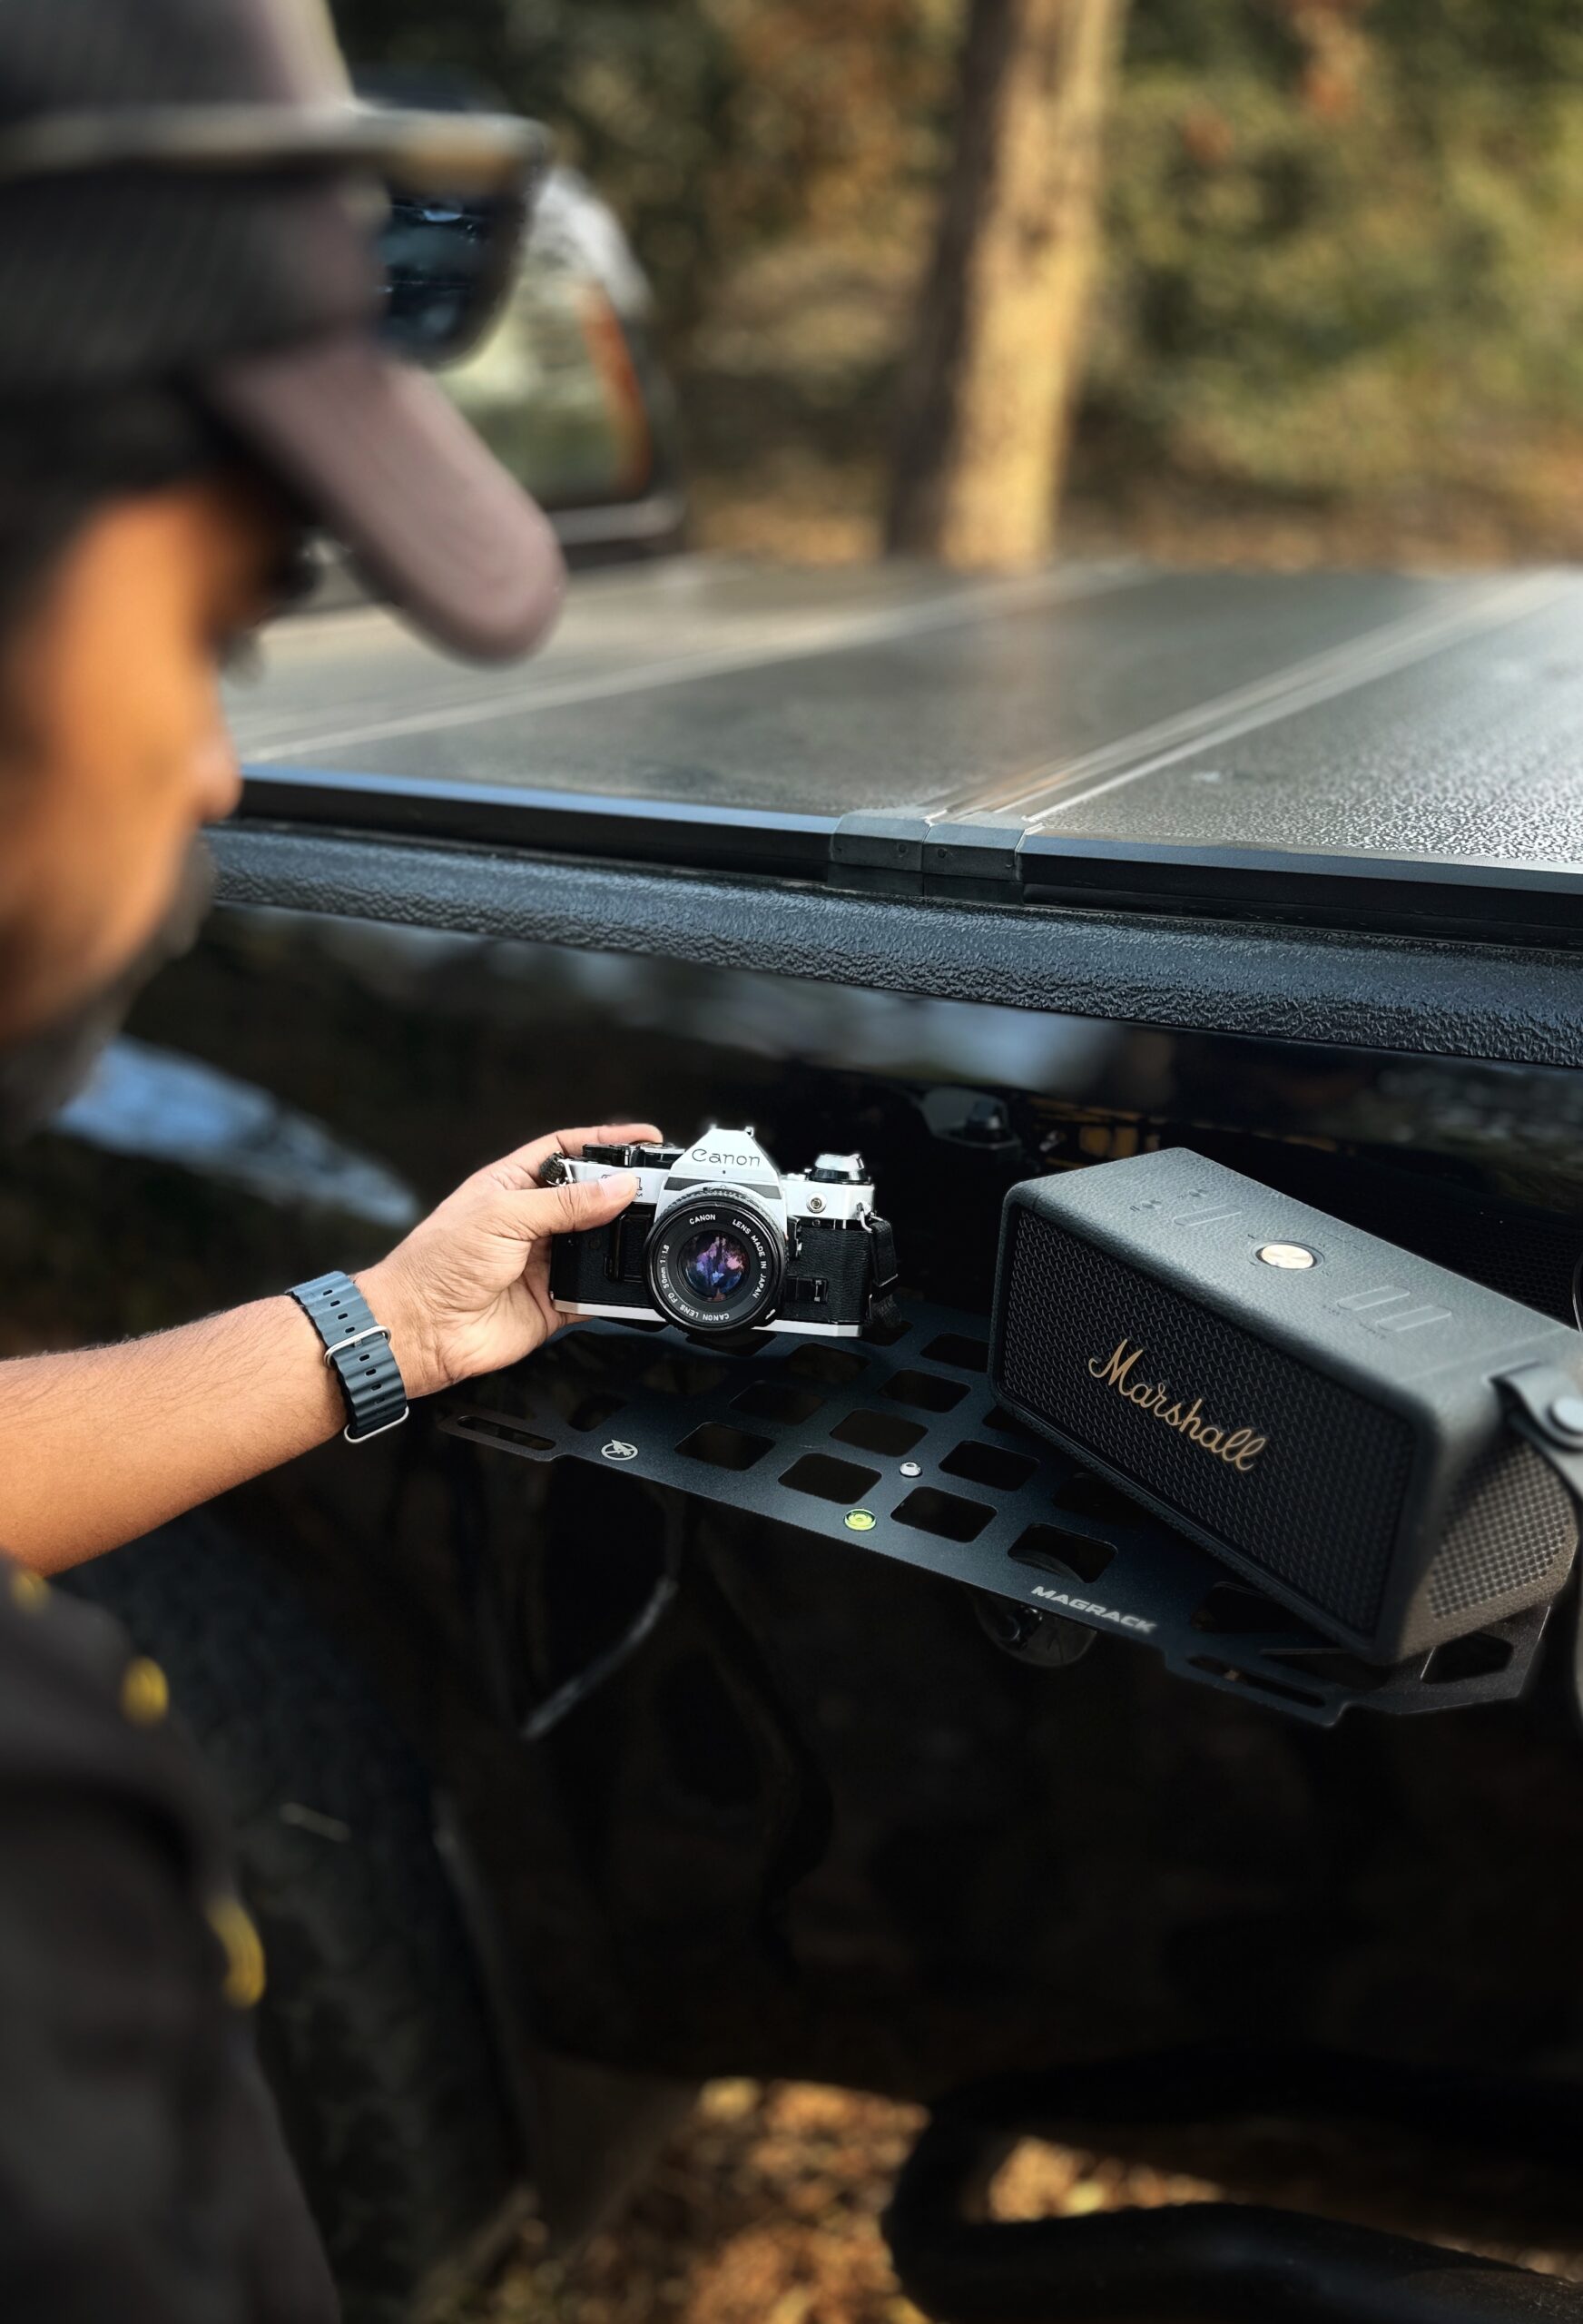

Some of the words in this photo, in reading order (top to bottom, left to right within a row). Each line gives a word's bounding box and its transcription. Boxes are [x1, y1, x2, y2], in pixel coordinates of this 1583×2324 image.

[692, 1148, 761, 1167] Canon
[689, 1214, 716, 1225] CANON
[732, 1218, 752, 1235] LENS
[751, 1235, 765, 1258] MADE
[760, 1260, 768, 1269] IN
[660, 1266, 670, 1289] 50mm
[752, 1274, 768, 1300] JAPAN
[667, 1292, 678, 1304] FD
[679, 1304, 699, 1318] LENS
[703, 1313, 730, 1322] CANON
[1087, 1337, 1269, 1472] Marshall
[1030, 1585, 1158, 1633] MAGRACK
